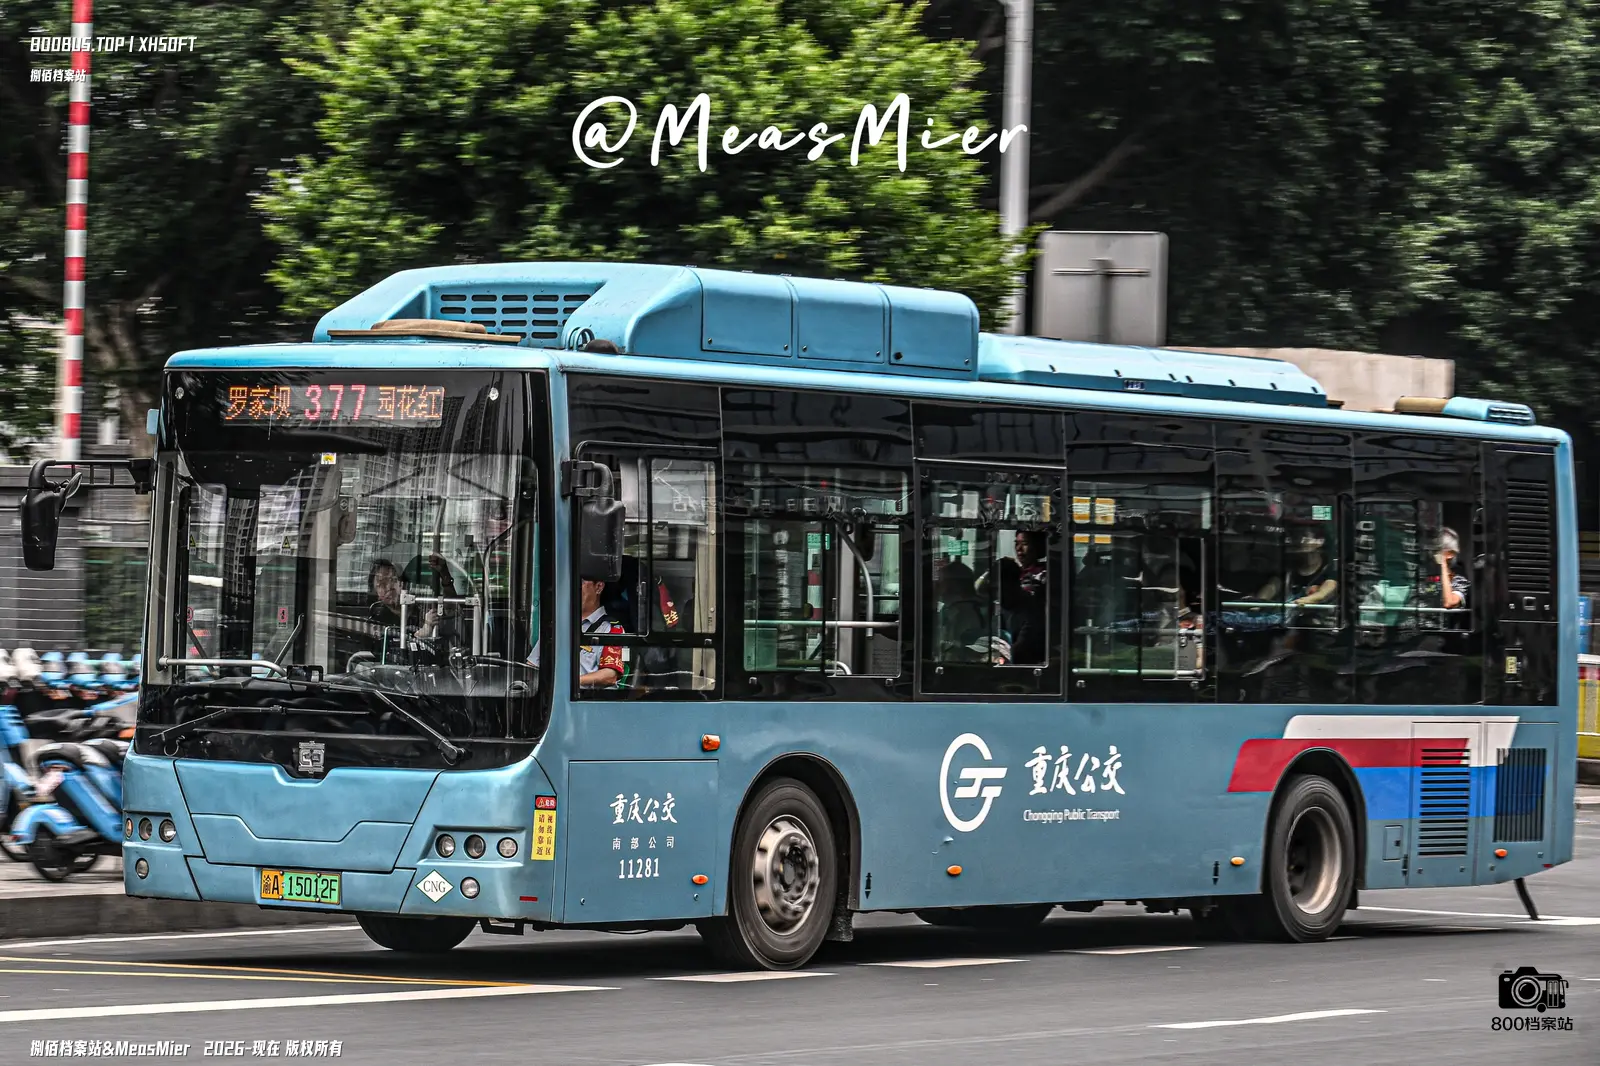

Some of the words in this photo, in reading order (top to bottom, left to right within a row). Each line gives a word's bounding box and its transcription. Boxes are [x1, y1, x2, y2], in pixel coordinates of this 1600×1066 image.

[225, 384, 291, 420] 罗家坝
[304, 384, 366, 420] 377
[1024, 745, 1126, 796] 重庆公交
[609, 792, 678, 824] 重庆公交
[1023, 809, 1064, 823] Chongqing
[1064, 808, 1086, 821] Public
[1086, 808, 1120, 822] Transport
[612, 836, 675, 850] 南部公司
[618, 857, 660, 879] 11281
[423, 880, 446, 893] CNG
